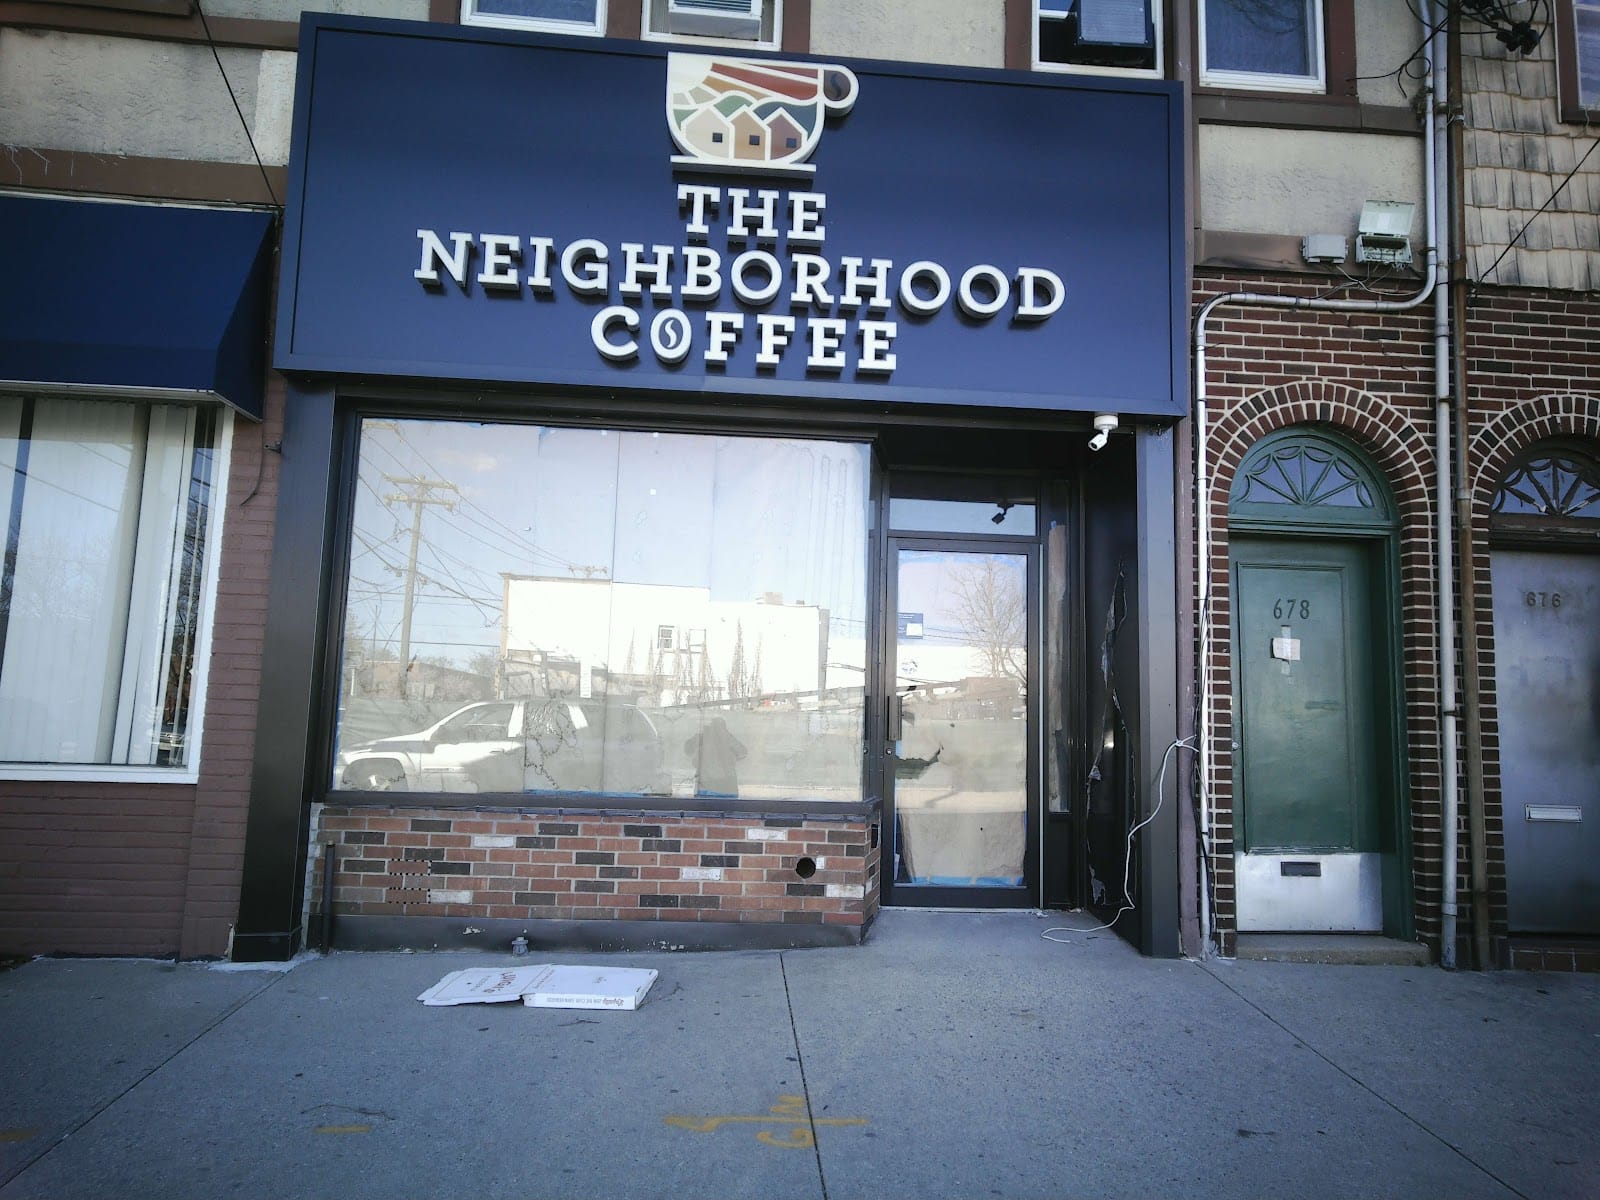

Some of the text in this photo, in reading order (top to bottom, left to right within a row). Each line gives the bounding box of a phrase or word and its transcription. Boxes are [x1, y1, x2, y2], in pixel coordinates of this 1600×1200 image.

[677, 184, 827, 245] THE
[413, 228, 1066, 321] NEIGHBORHOOD
[590, 305, 898, 375] COFFEE
[1273, 598, 1310, 620] 678
[1526, 591, 1561, 608] 676
